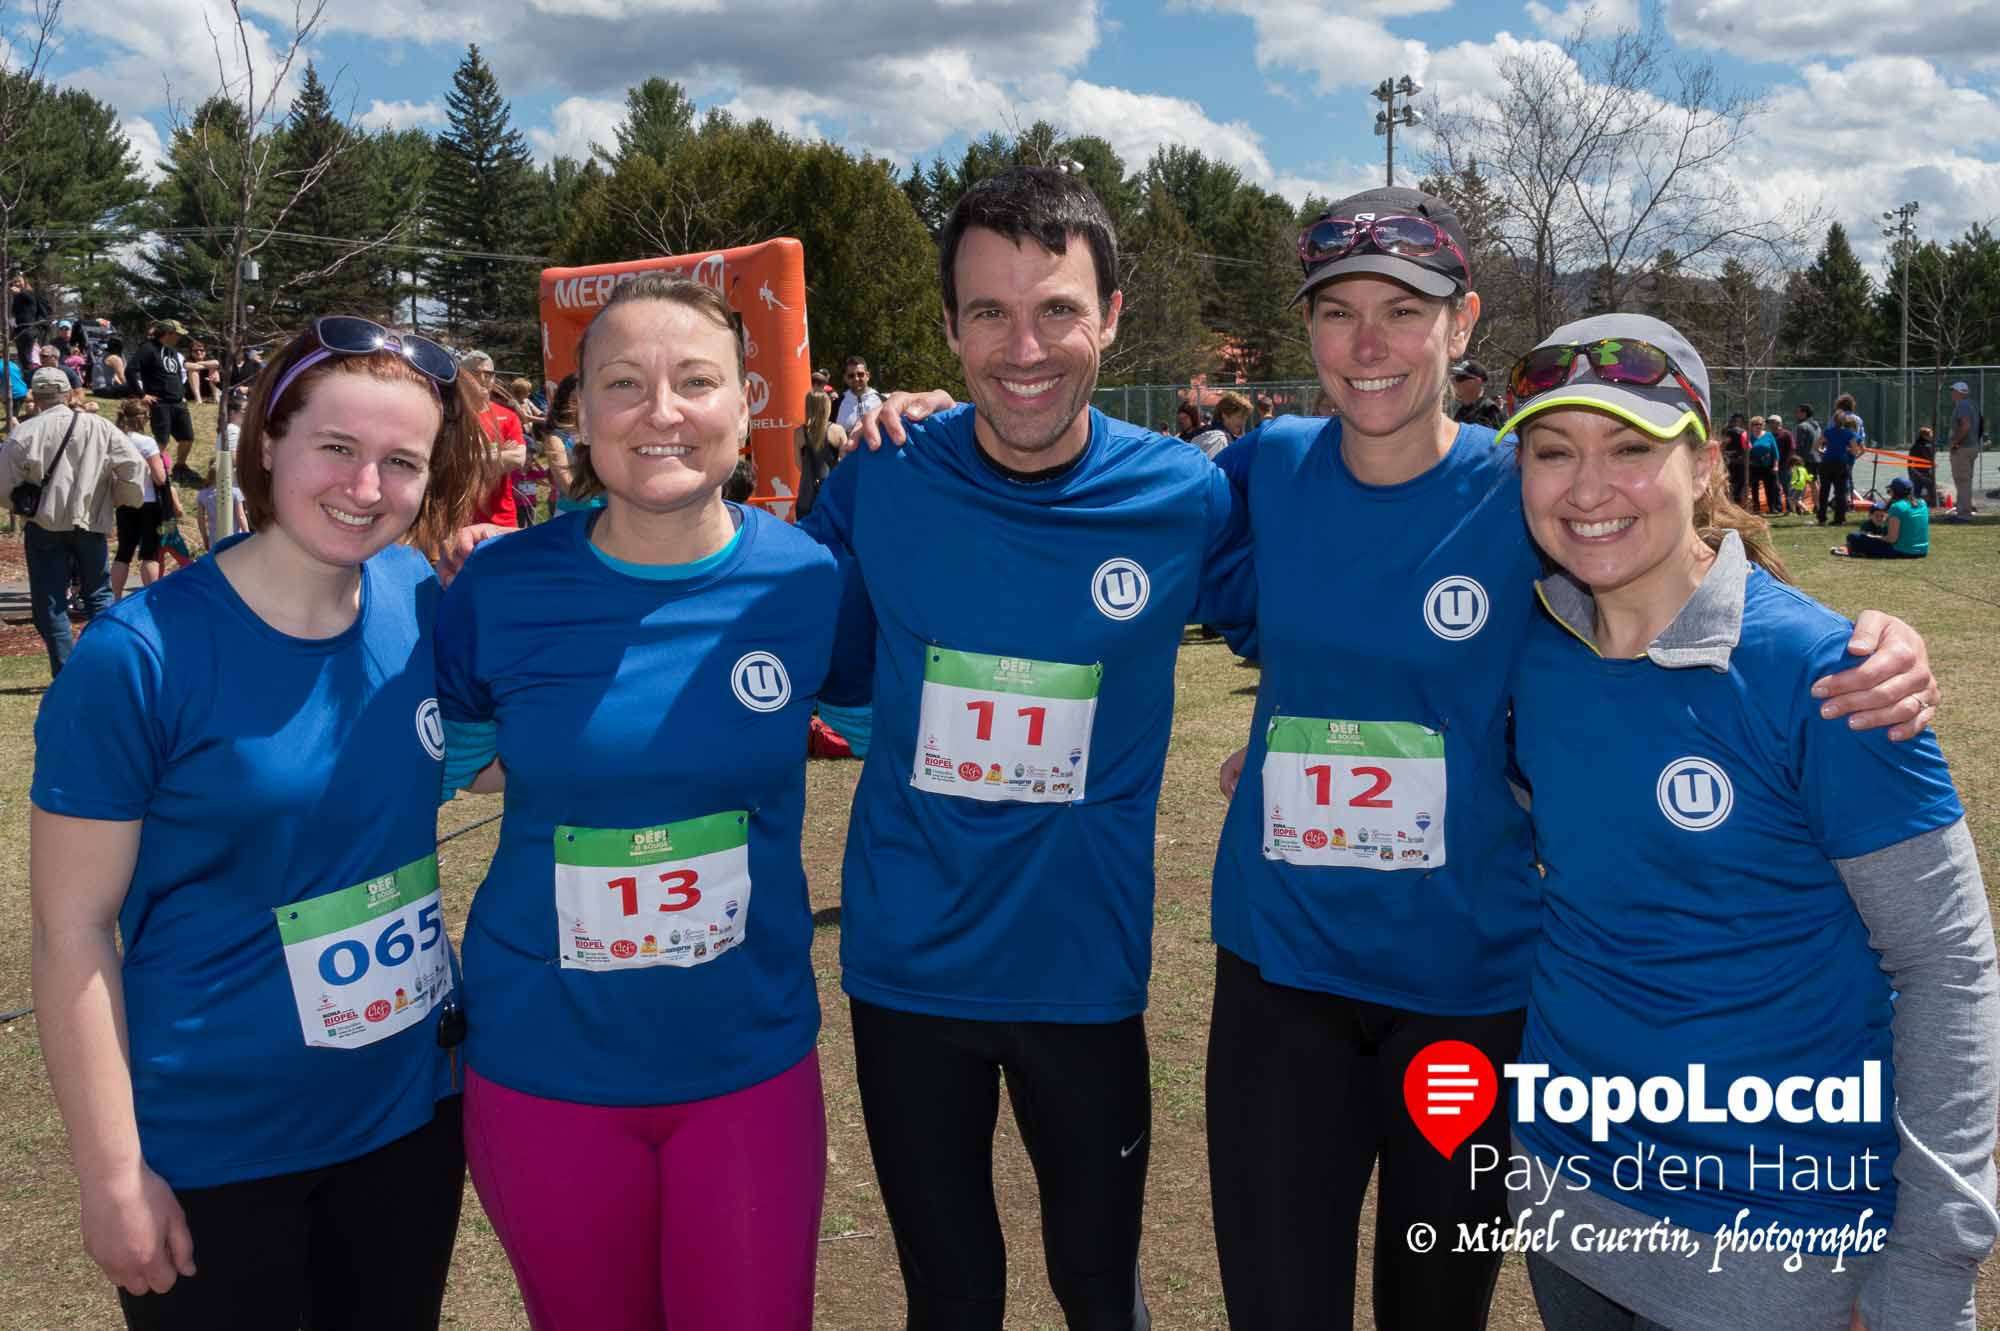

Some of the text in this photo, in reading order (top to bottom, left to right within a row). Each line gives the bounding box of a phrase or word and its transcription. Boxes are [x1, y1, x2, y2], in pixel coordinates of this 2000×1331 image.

[750, 417, 793, 429] RELL
[966, 700, 1046, 746] 11
[925, 757, 953, 767] RIOPEL
[1304, 765, 1393, 808] 12
[607, 869, 702, 917] 13
[318, 901, 442, 986] 065
